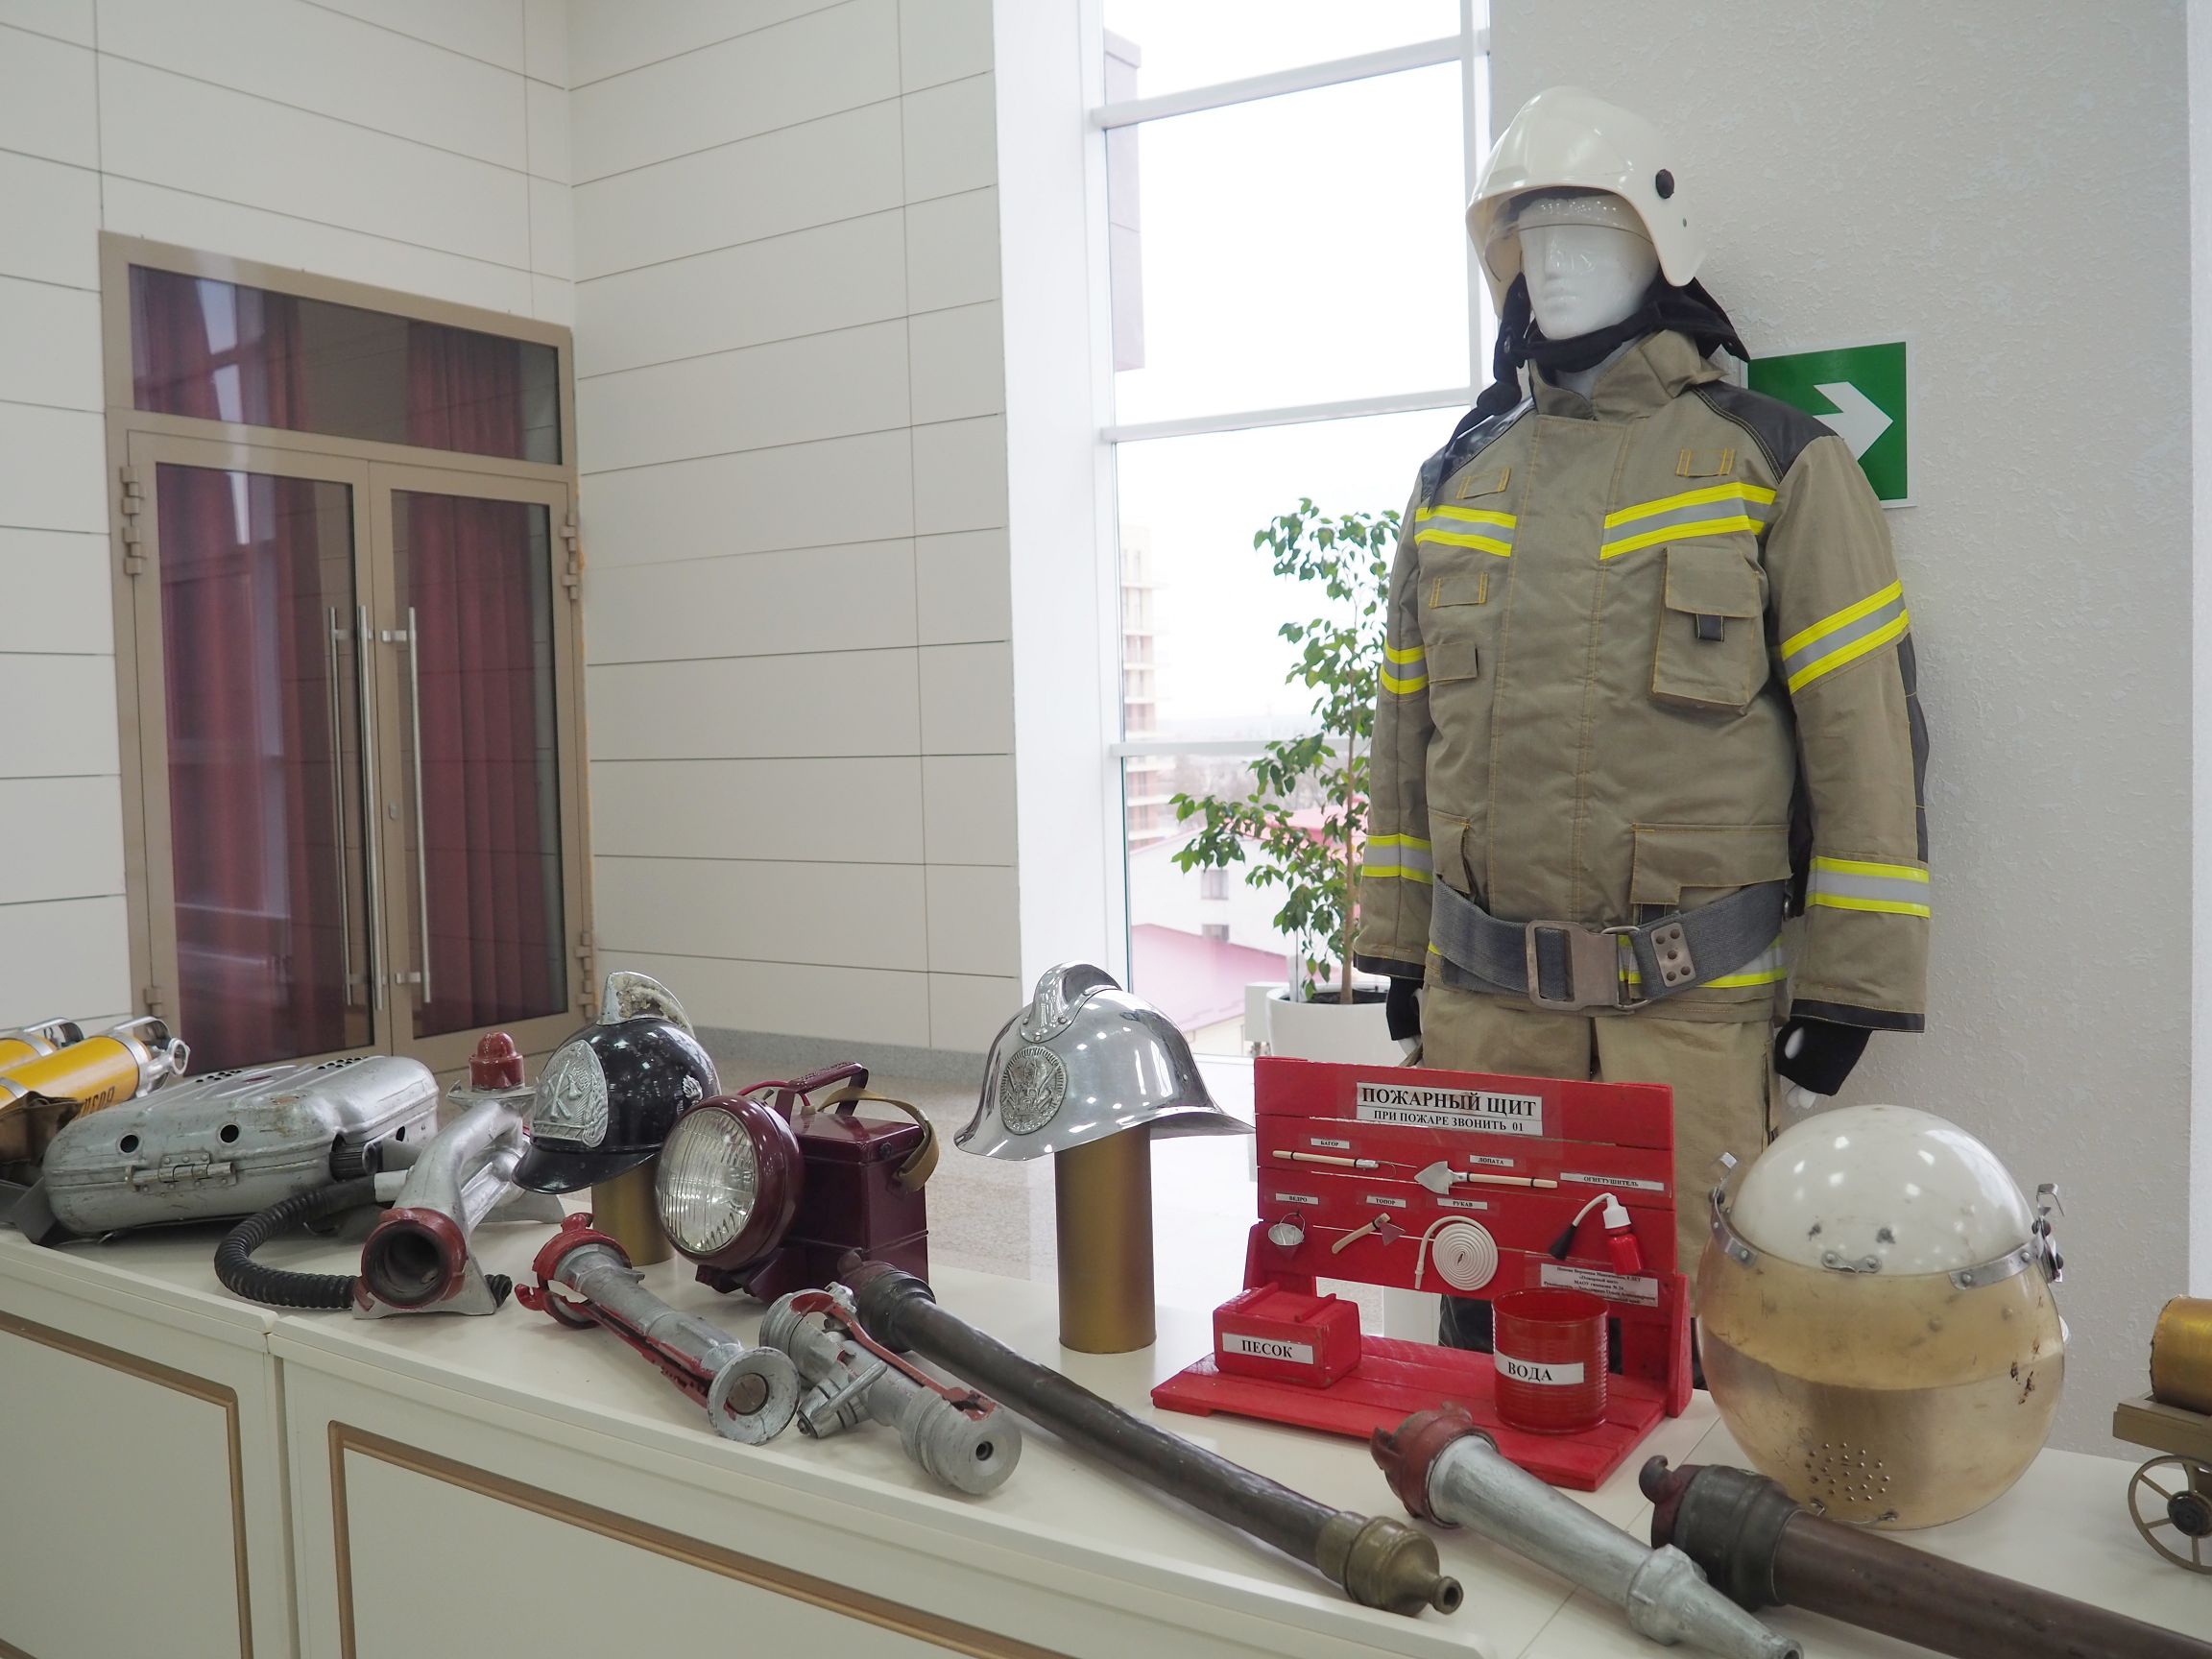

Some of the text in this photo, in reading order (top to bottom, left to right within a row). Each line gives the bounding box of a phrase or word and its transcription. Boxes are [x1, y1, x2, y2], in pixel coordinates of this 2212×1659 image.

[1362, 1088, 1536, 1118] ПОЖАРНЫЙ ЩИТ
[1374, 1110, 1524, 1132] ПРИ ПОЖАРЕ ЗВОНИТЬ 01
[1478, 1157, 1504, 1166] ЛОПАТА
[1583, 1176, 1639, 1187] ОГНЕТУШИТЕЛЬ
[1241, 1339, 1292, 1358] ПЕСОК
[1507, 1361, 1552, 1382] ВОДА
